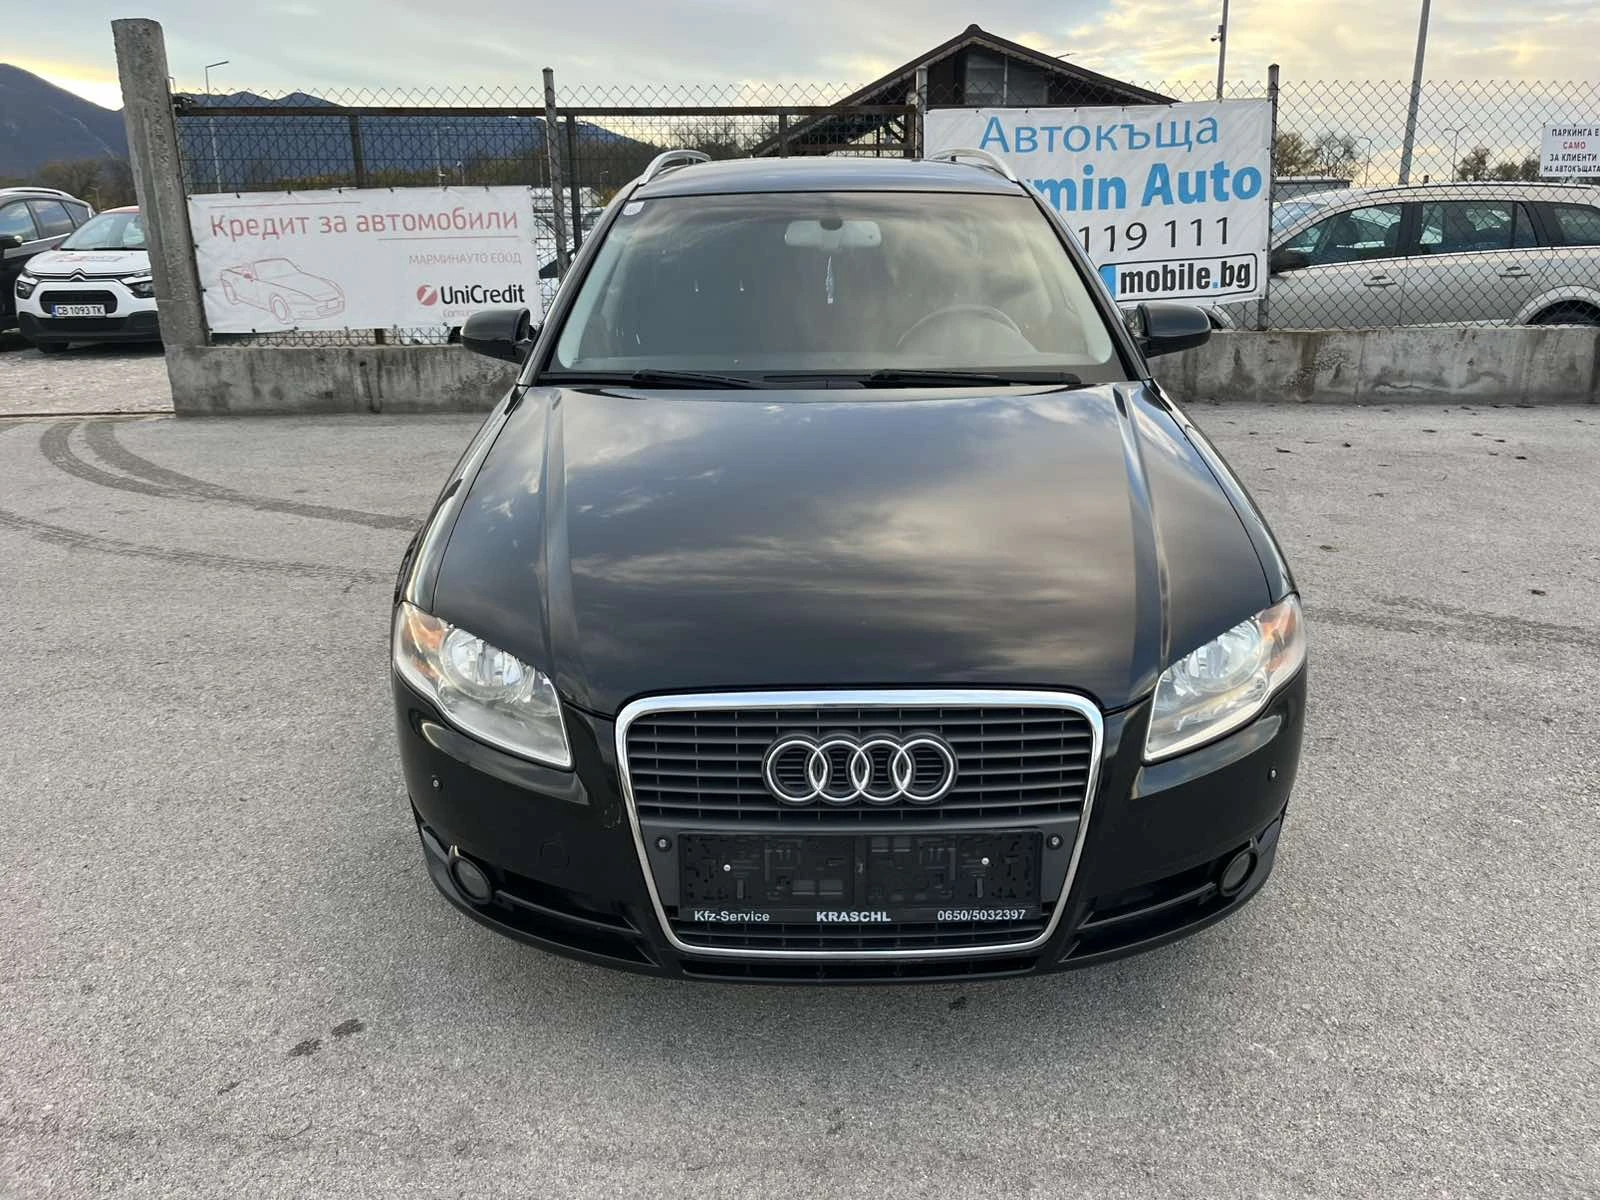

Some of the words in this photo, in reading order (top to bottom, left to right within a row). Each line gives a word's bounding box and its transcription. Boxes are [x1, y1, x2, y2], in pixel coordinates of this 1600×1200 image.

[979, 116, 1219, 153] Автокъща
[1563, 141, 1586, 149] САМО
[1550, 153, 1559, 162] ЗА
[1562, 153, 1597, 162] КЛИЕНТИ
[1025, 164, 1127, 211] min
[1141, 160, 1263, 207] Auto
[210, 213, 310, 242] Кредит
[320, 216, 347, 234] за
[356, 206, 518, 234] автомобили
[1164, 217, 1229, 248] 111
[490, 251, 522, 264] ЕООД
[1120, 261, 1251, 294] mobile.bg
[440, 284, 526, 305] UniCredit
[694, 910, 770, 922] Kfz-Service
[816, 911, 892, 923] KRASCHL
[936, 909, 1026, 922] 0650/5032397
